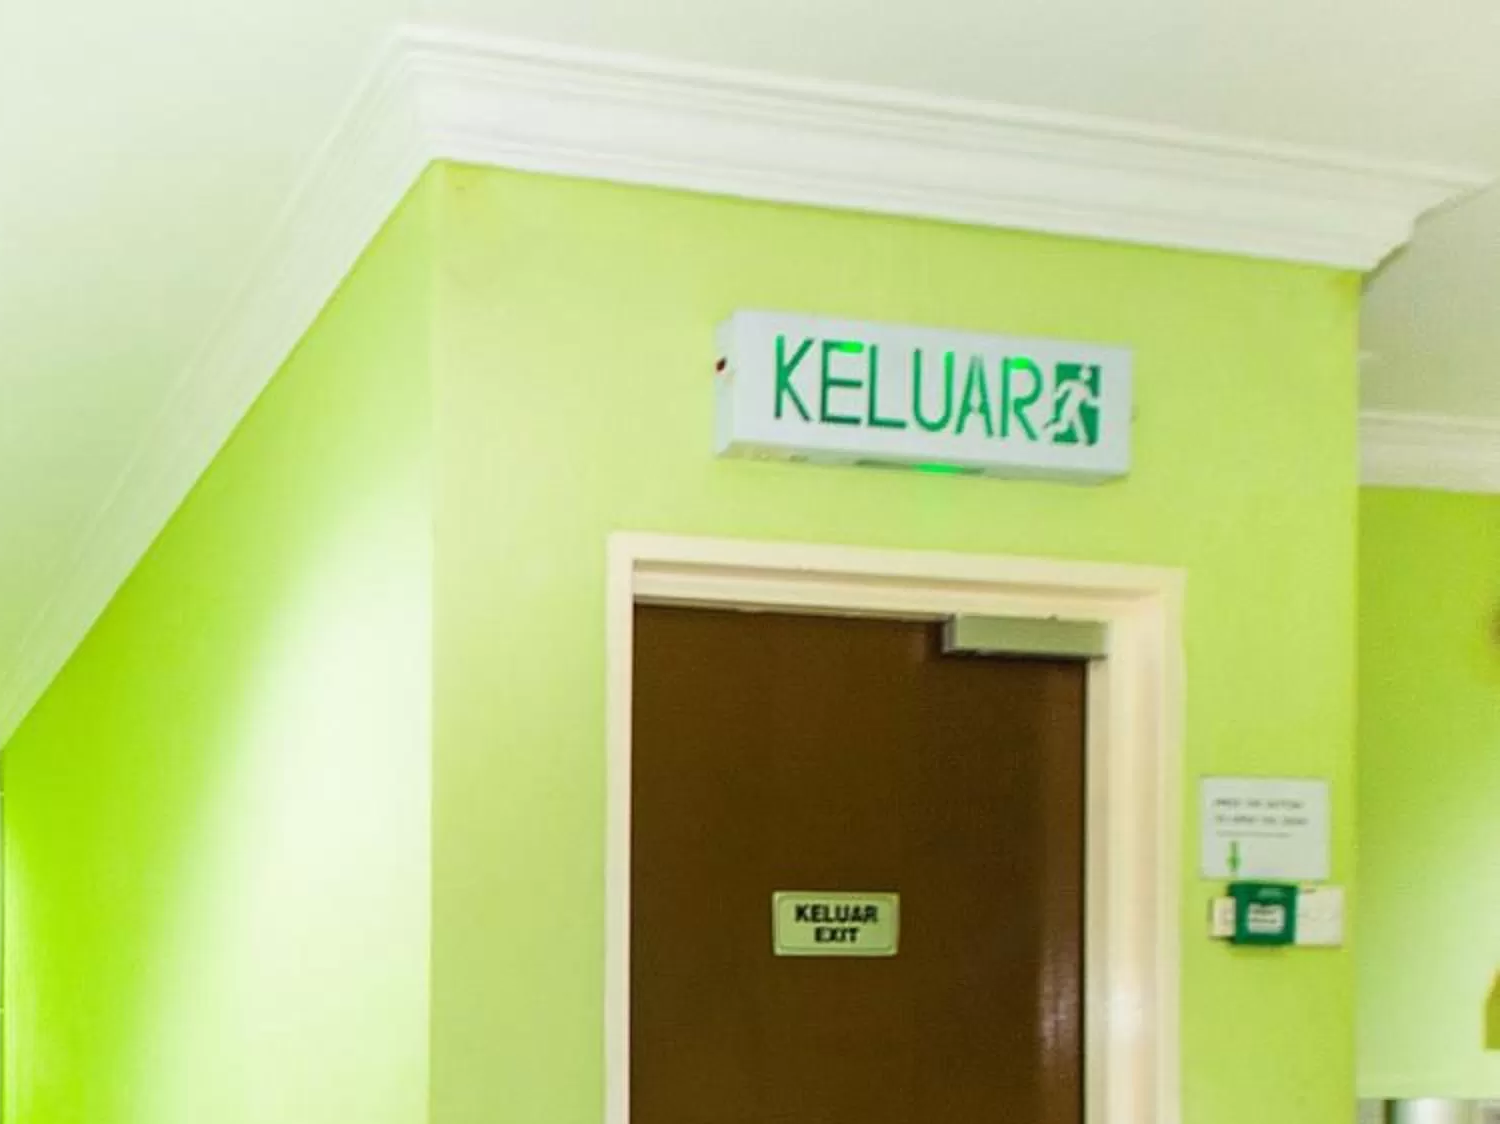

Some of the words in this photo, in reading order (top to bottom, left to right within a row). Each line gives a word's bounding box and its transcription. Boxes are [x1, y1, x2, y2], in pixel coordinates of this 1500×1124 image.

[774, 334, 1044, 442] KELUAR
[795, 904, 878, 923] KELUAR
[814, 926, 859, 943] EXIT
